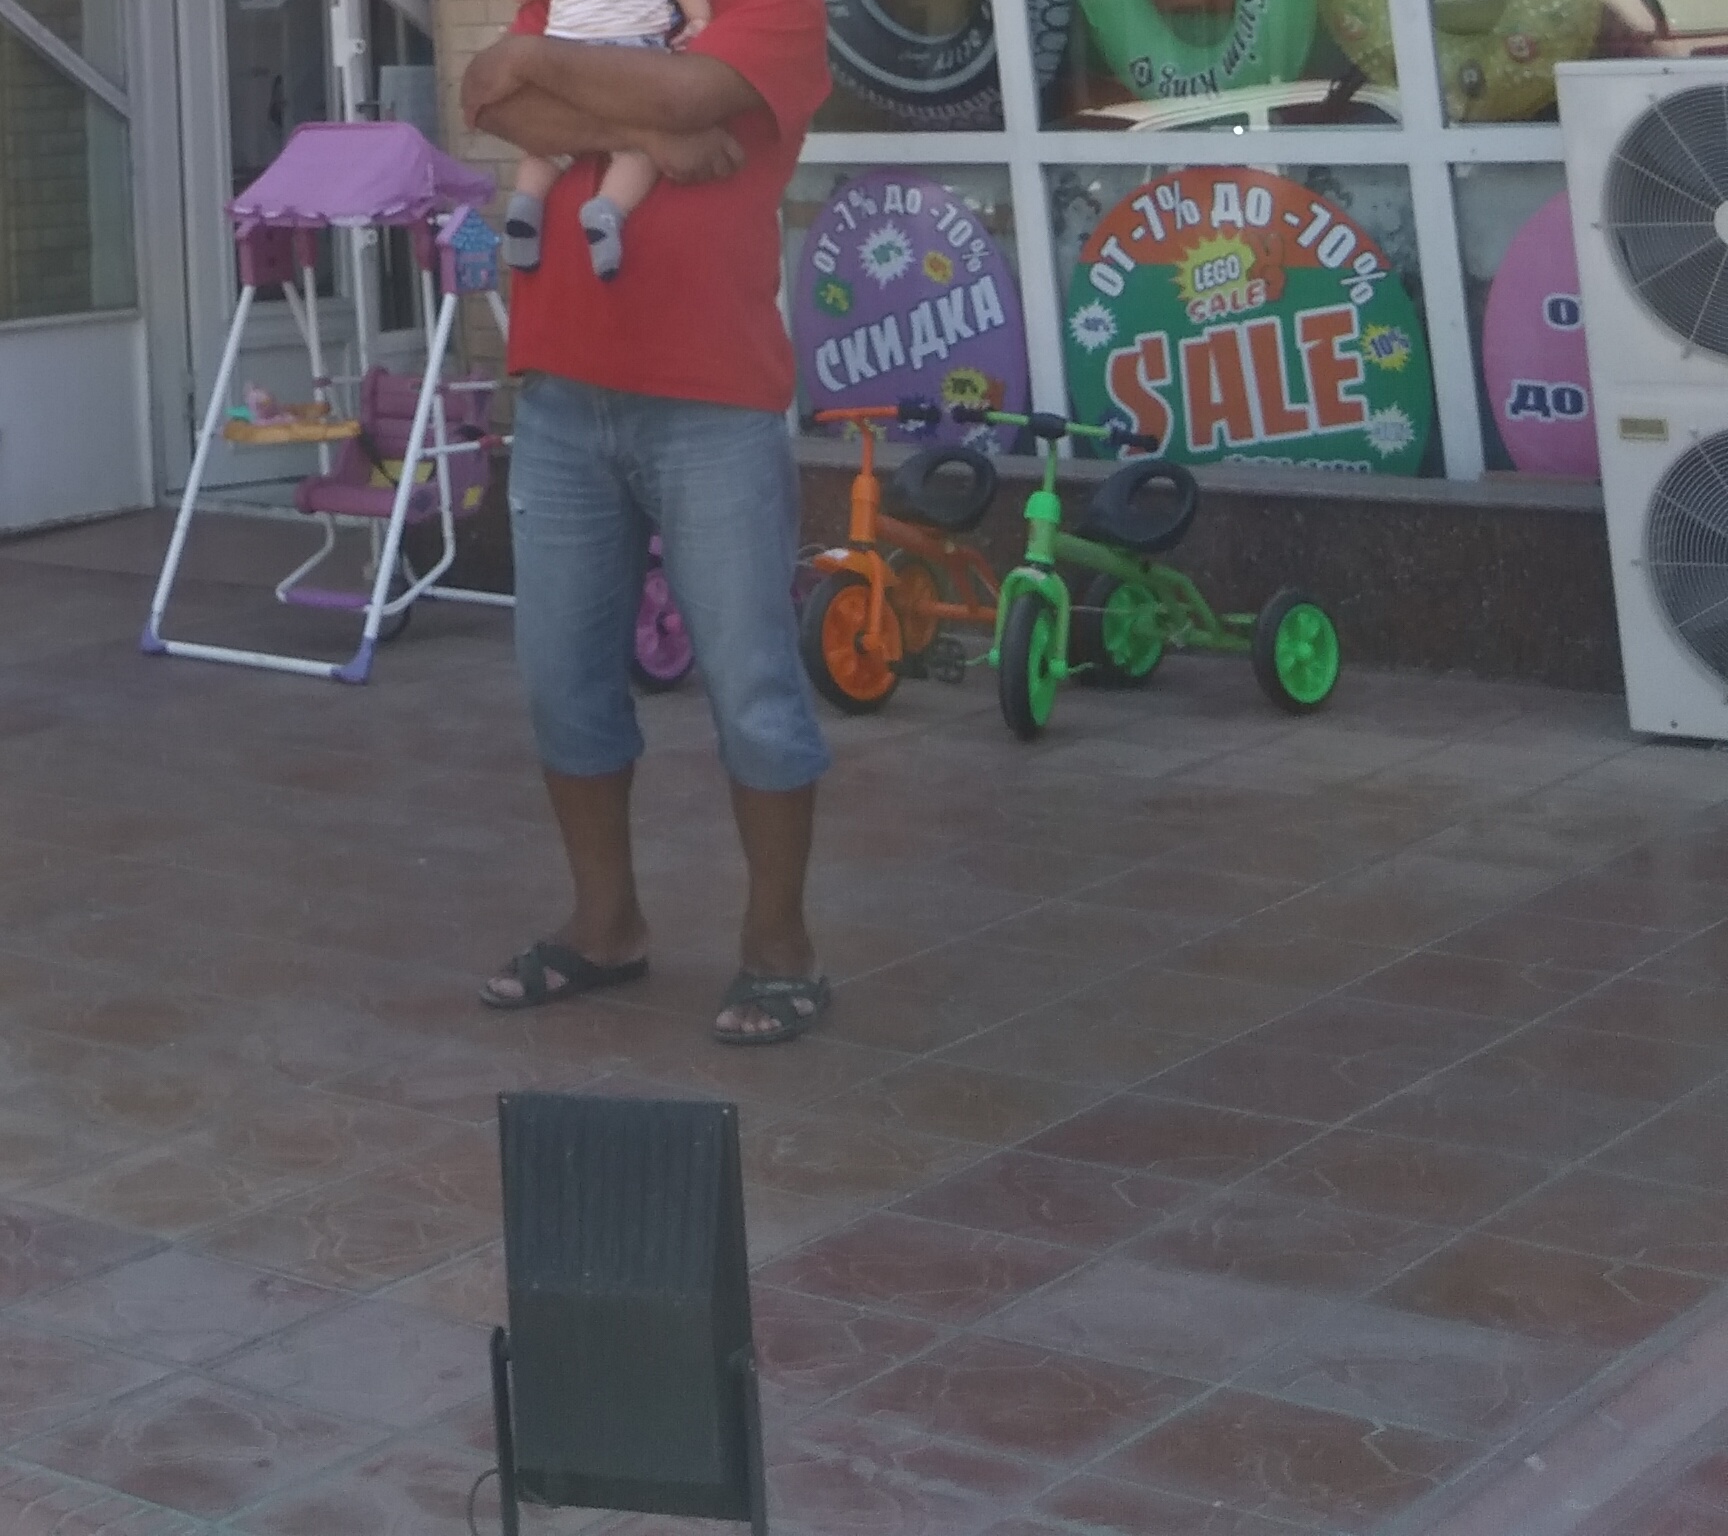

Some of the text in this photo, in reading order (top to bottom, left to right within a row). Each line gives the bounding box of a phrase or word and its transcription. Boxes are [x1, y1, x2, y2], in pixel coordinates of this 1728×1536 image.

[812, 233, 841, 274] ОТ
[883, 184, 923, 215] ДО
[1088, 235, 1137, 298] ОТ
[1209, 181, 1273, 229] ДО
[1191, 253, 1243, 294] LEGO
[815, 275, 1006, 393] СКИДКА
[1185, 278, 1267, 325] SALE
[1105, 302, 1376, 462] SALE
[1505, 379, 1590, 421] ДО
